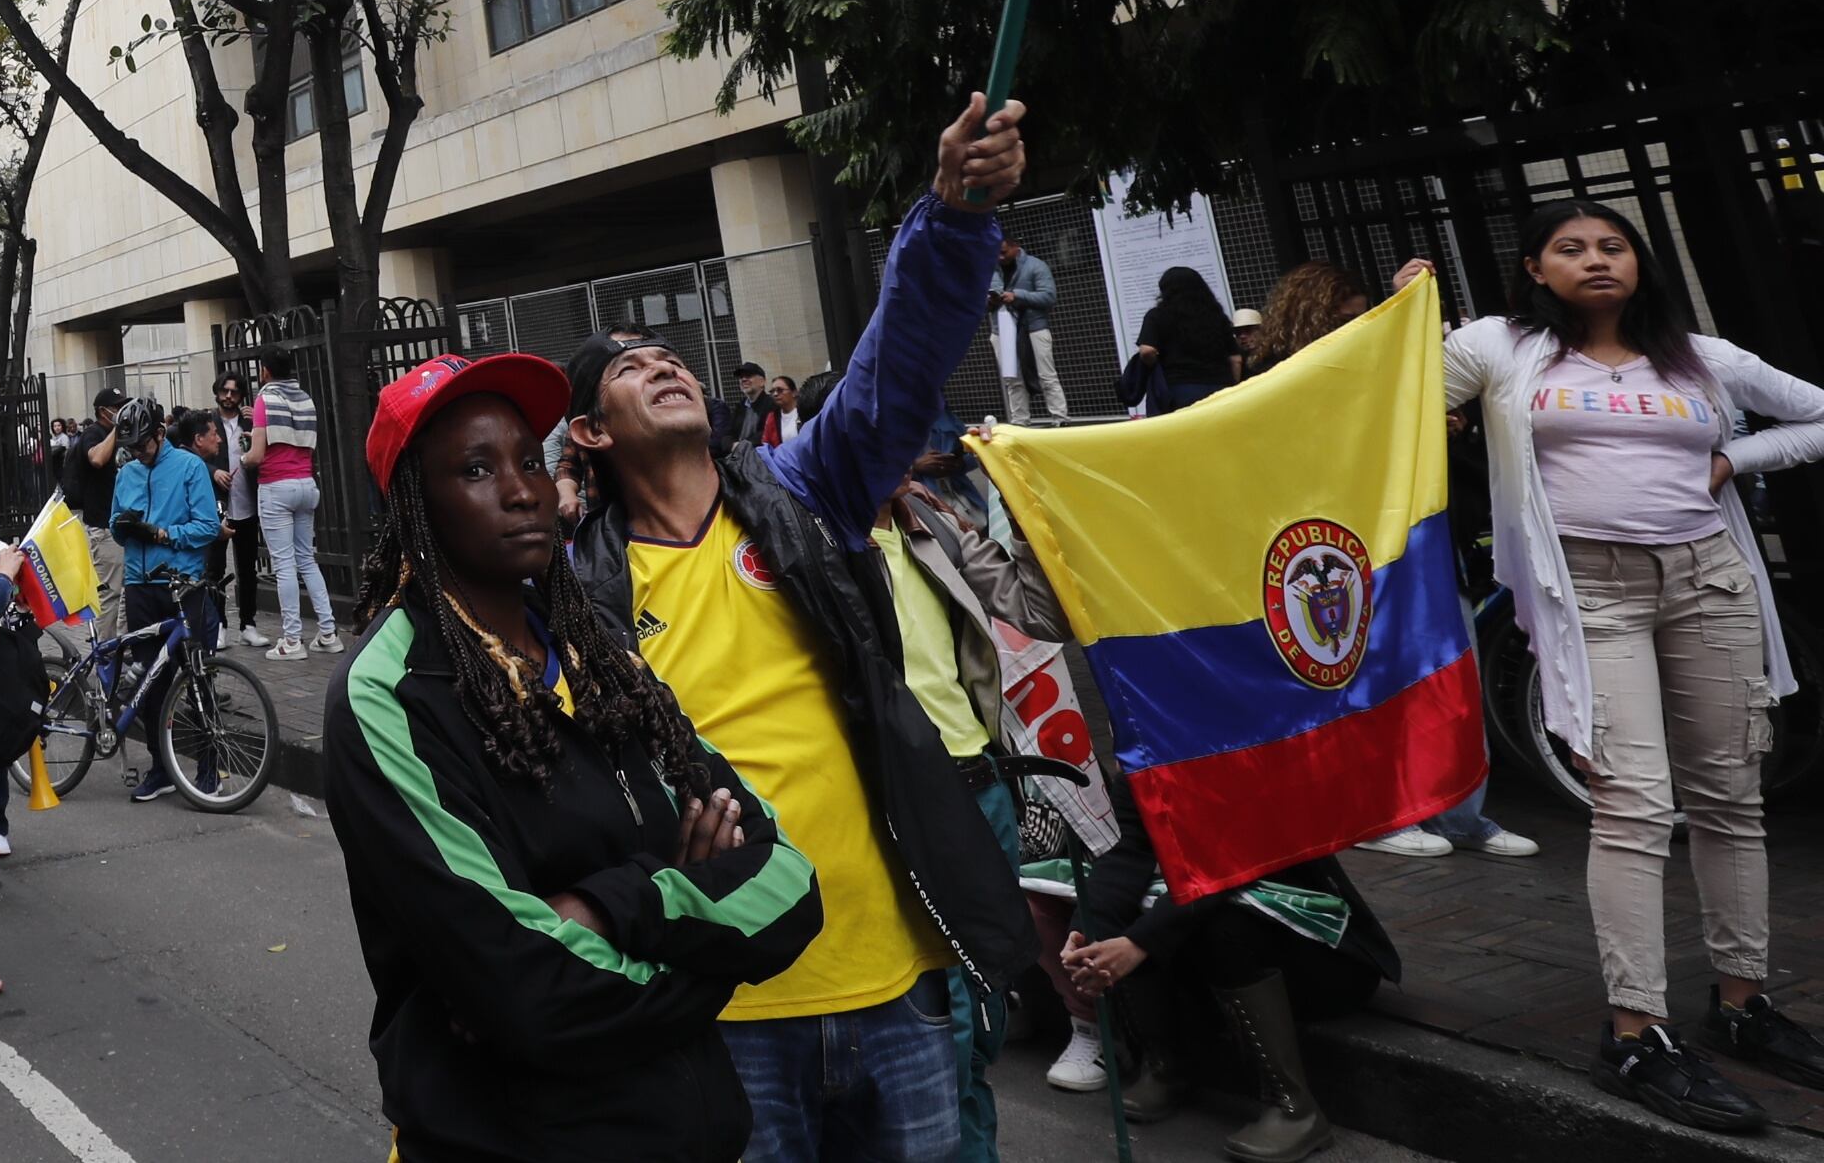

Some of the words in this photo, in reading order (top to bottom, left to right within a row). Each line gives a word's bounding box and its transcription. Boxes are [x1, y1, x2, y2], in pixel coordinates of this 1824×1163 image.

[1530, 387, 1710, 425] WEEKEND
[26, 544, 58, 602] COLOMBIA
[1267, 525, 1369, 589] REPUBLICA
[638, 620, 668, 641] didas
[1278, 628, 1302, 661] DE
[1308, 602, 1370, 683] COLOMBIA
